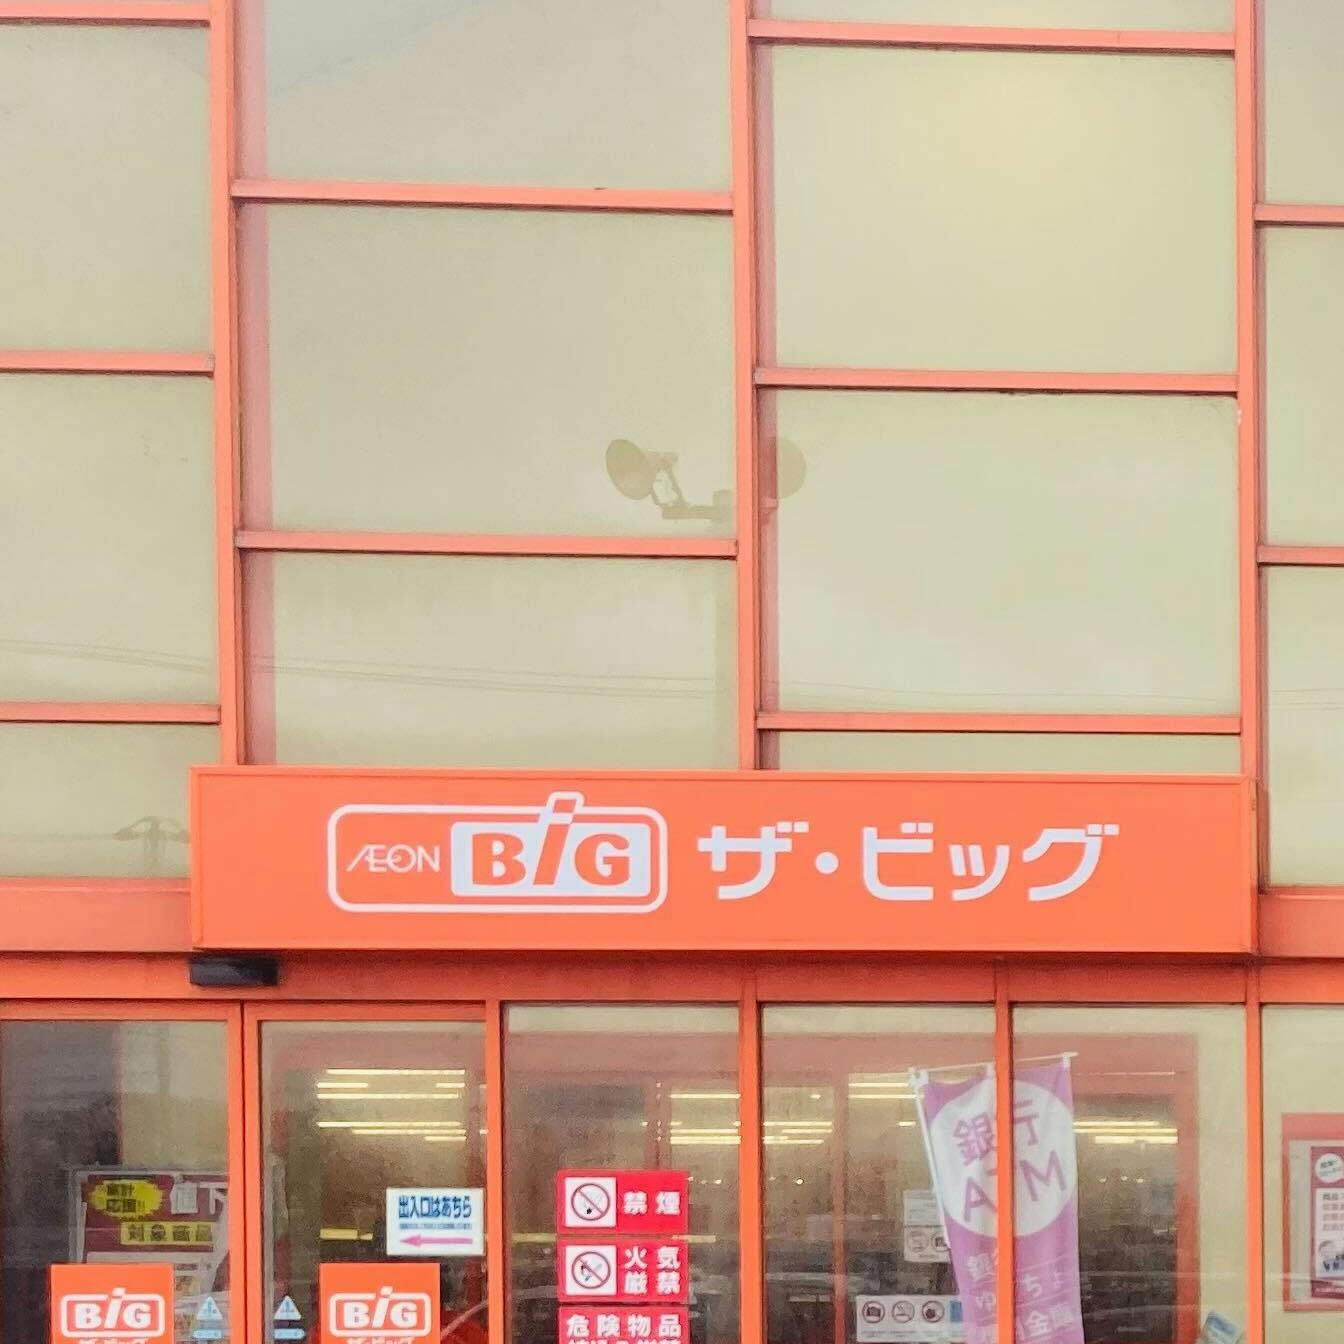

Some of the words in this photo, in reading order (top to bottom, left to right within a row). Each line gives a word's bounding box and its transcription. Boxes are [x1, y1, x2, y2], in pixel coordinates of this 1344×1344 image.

[697, 821, 1119, 902] ザ・ビッグ
[963, 1150, 1067, 1222] AM
[399, 1195, 472, 1218] 出入口はあちら
[623, 1190, 681, 1217] 禁煙
[624, 1245, 681, 1269] 火気
[624, 1271, 681, 1295] 厳禁
[567, 1314, 682, 1339] 危険物品
